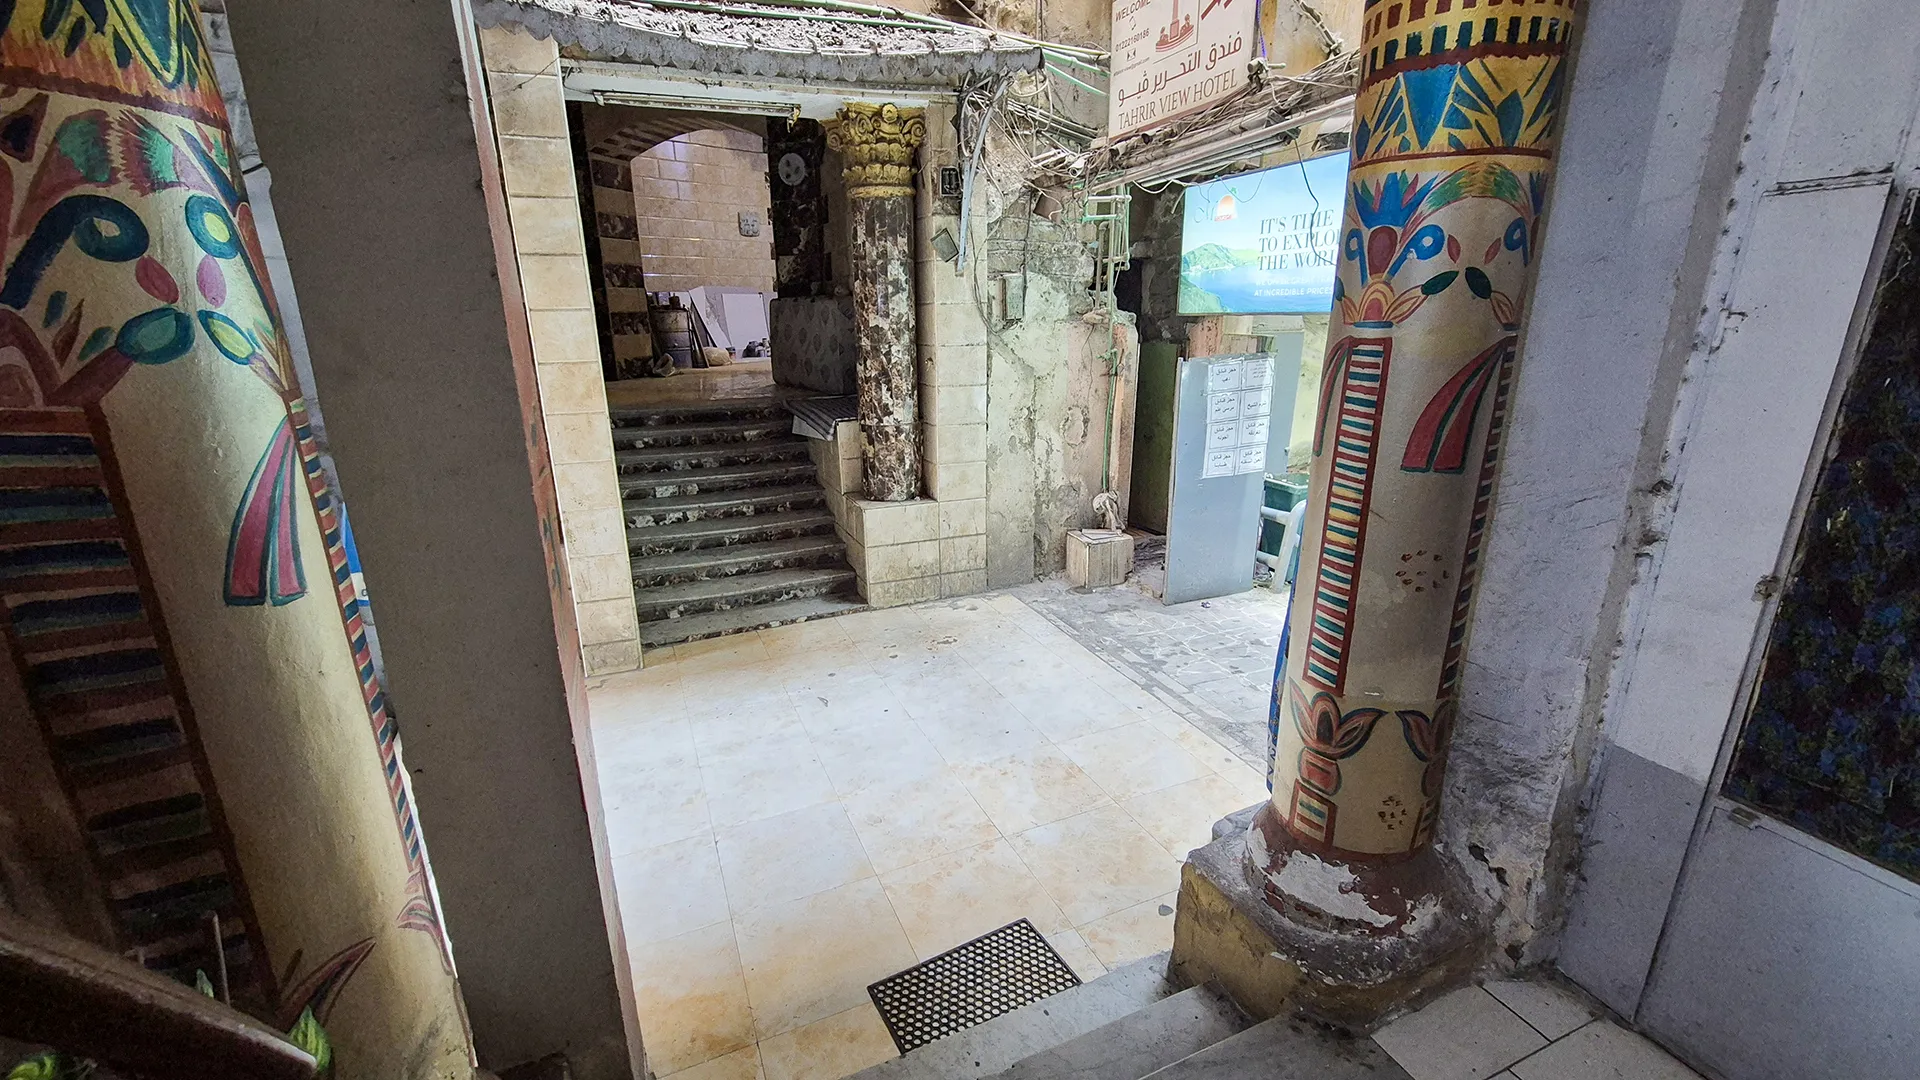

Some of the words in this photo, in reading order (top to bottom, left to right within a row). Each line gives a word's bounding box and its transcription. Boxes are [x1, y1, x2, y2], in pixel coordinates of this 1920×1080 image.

[1115, 0, 1151, 22] WELCOME
[1205, 31, 1242, 71] فندق
[1150, 49, 1202, 96] التحرير
[1118, 101, 1157, 130] TAHRIR
[1159, 86, 1192, 113] VIEW
[1193, 68, 1238, 103] HOTEL
[1260, 216, 1287, 235] IT'S
[1291, 209, 1334, 231] TIME
[1259, 236, 1278, 253] TO
[1283, 229, 1340, 251] EXPLO
[1257, 253, 1289, 271] THE
[1254, 289, 1262, 297] AT
[1263, 287, 1305, 297] INCREDIBLE
